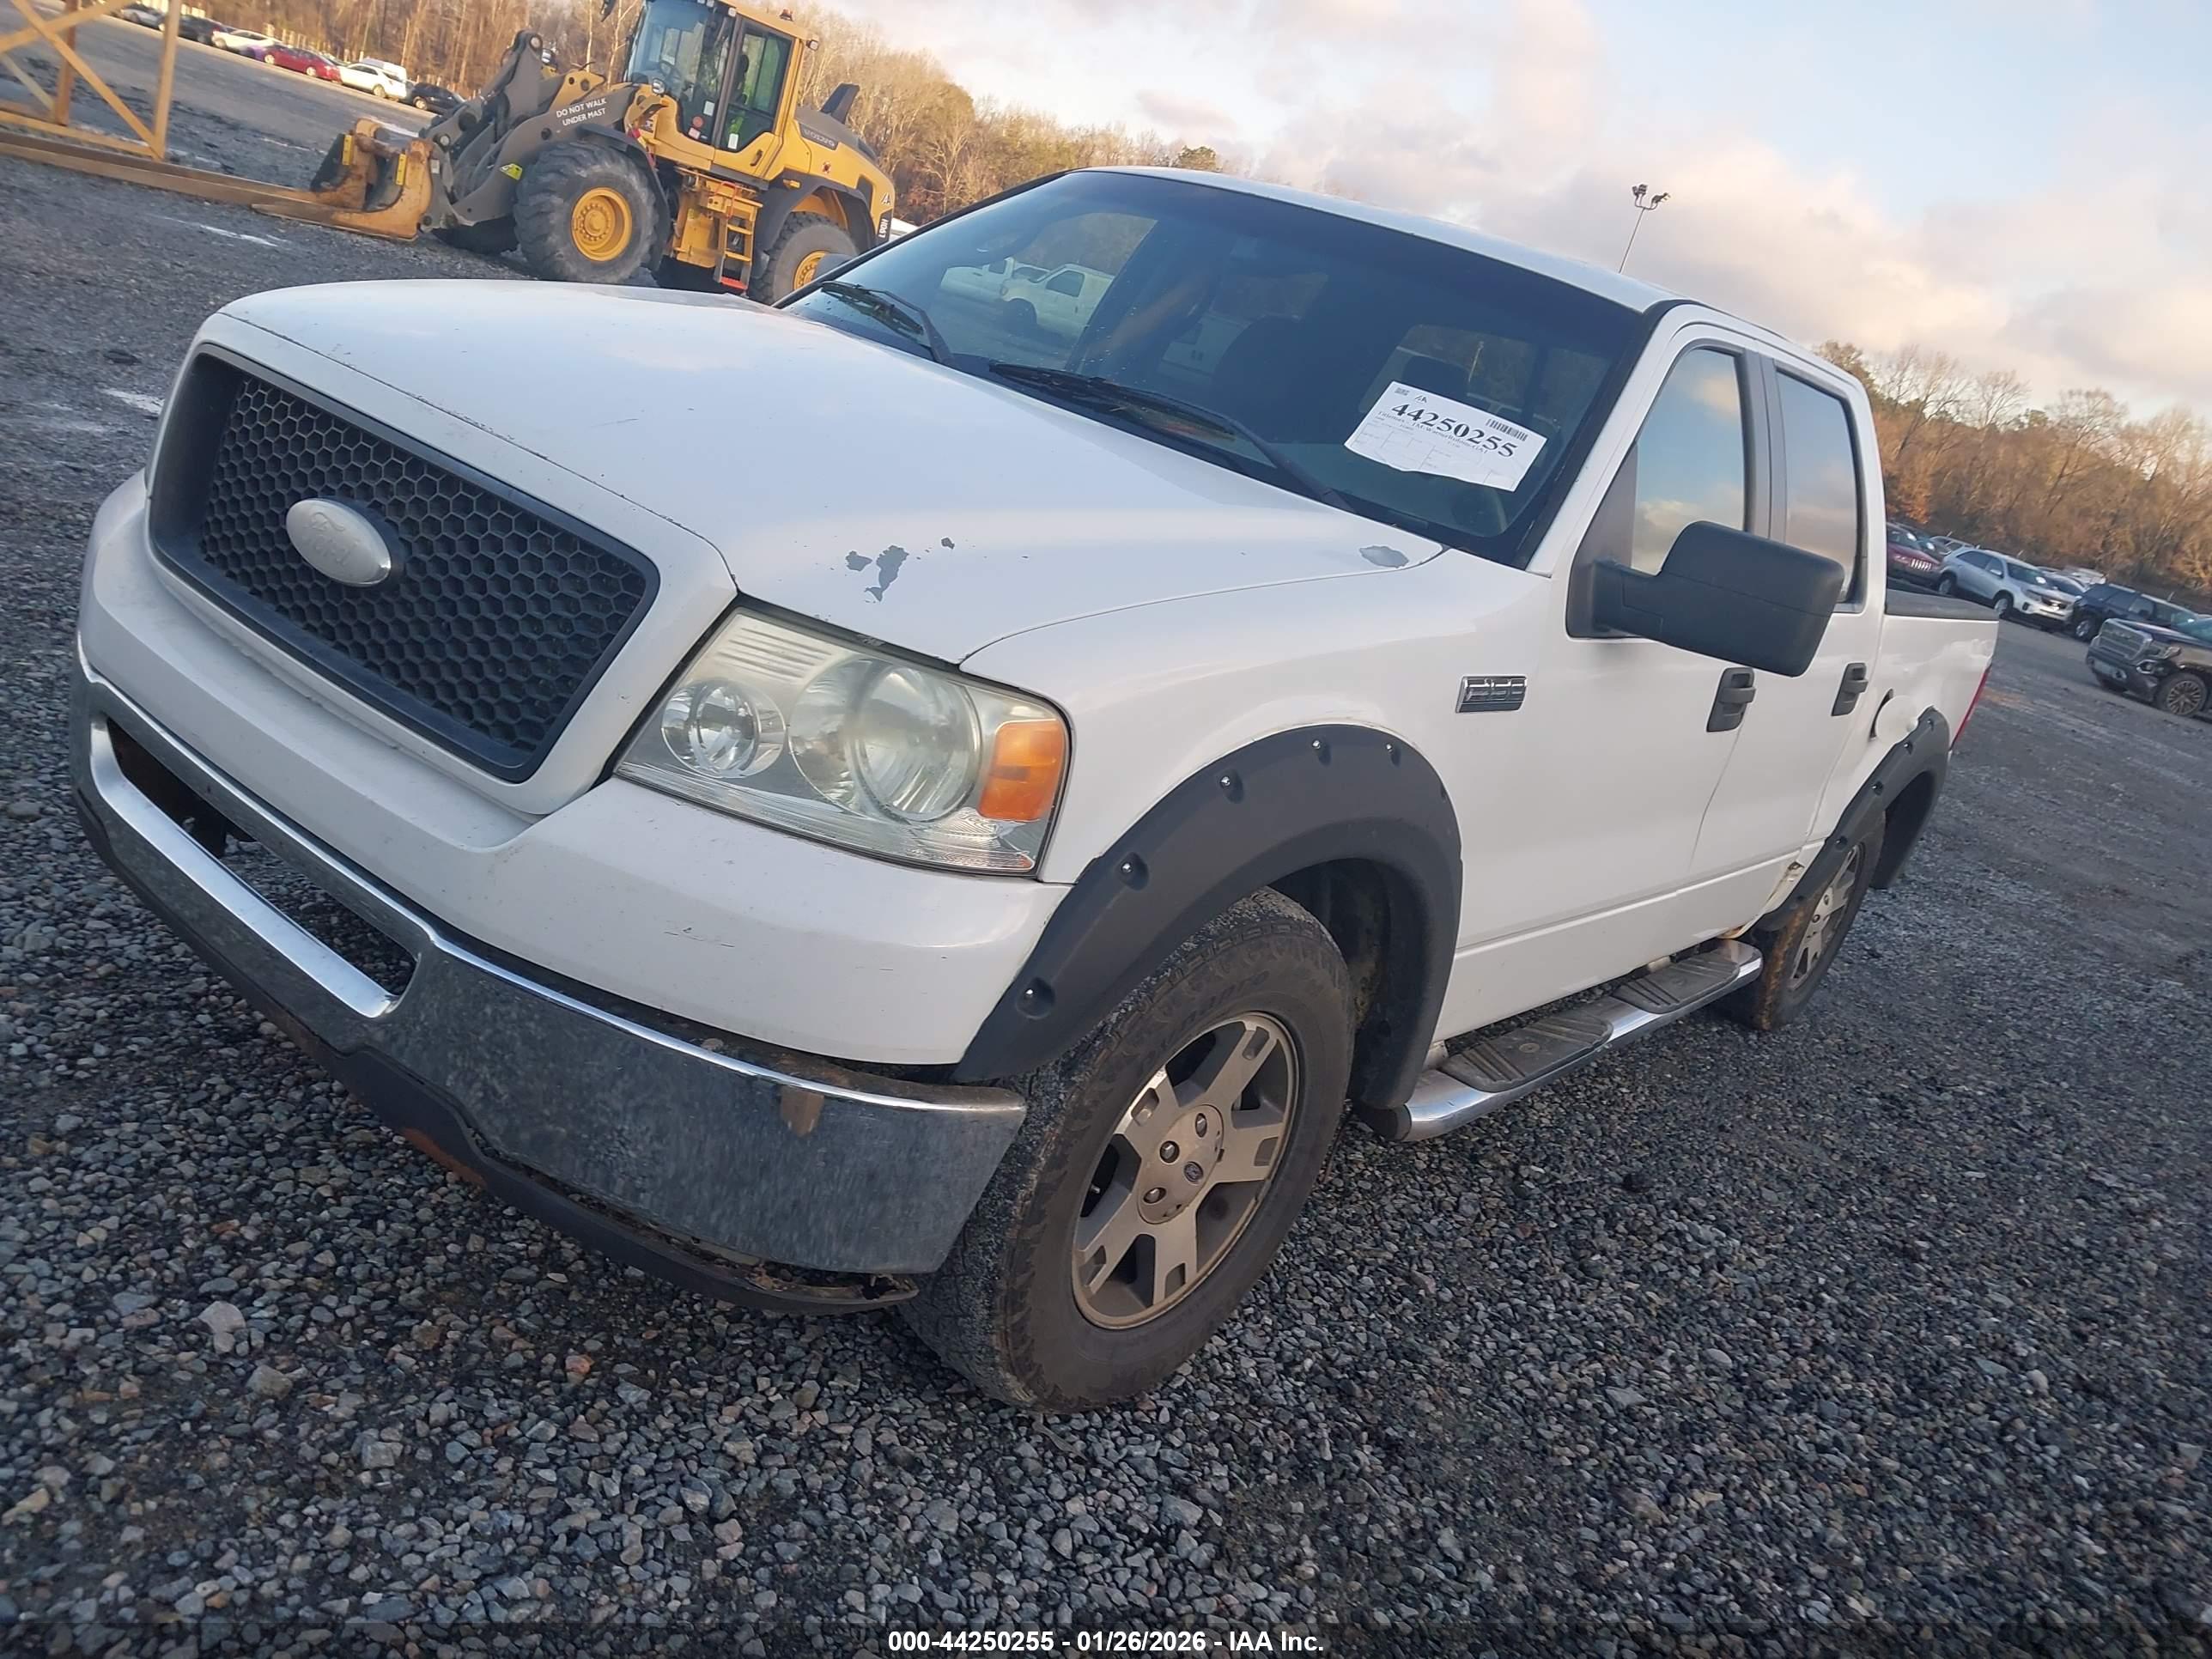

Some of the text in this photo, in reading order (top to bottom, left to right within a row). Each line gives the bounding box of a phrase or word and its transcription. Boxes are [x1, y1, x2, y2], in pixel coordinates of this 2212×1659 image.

[556, 97, 607, 118] DO NOT WALK
[562, 107, 606, 126] UNDER MAST
[1391, 403, 1518, 459] 44250255
